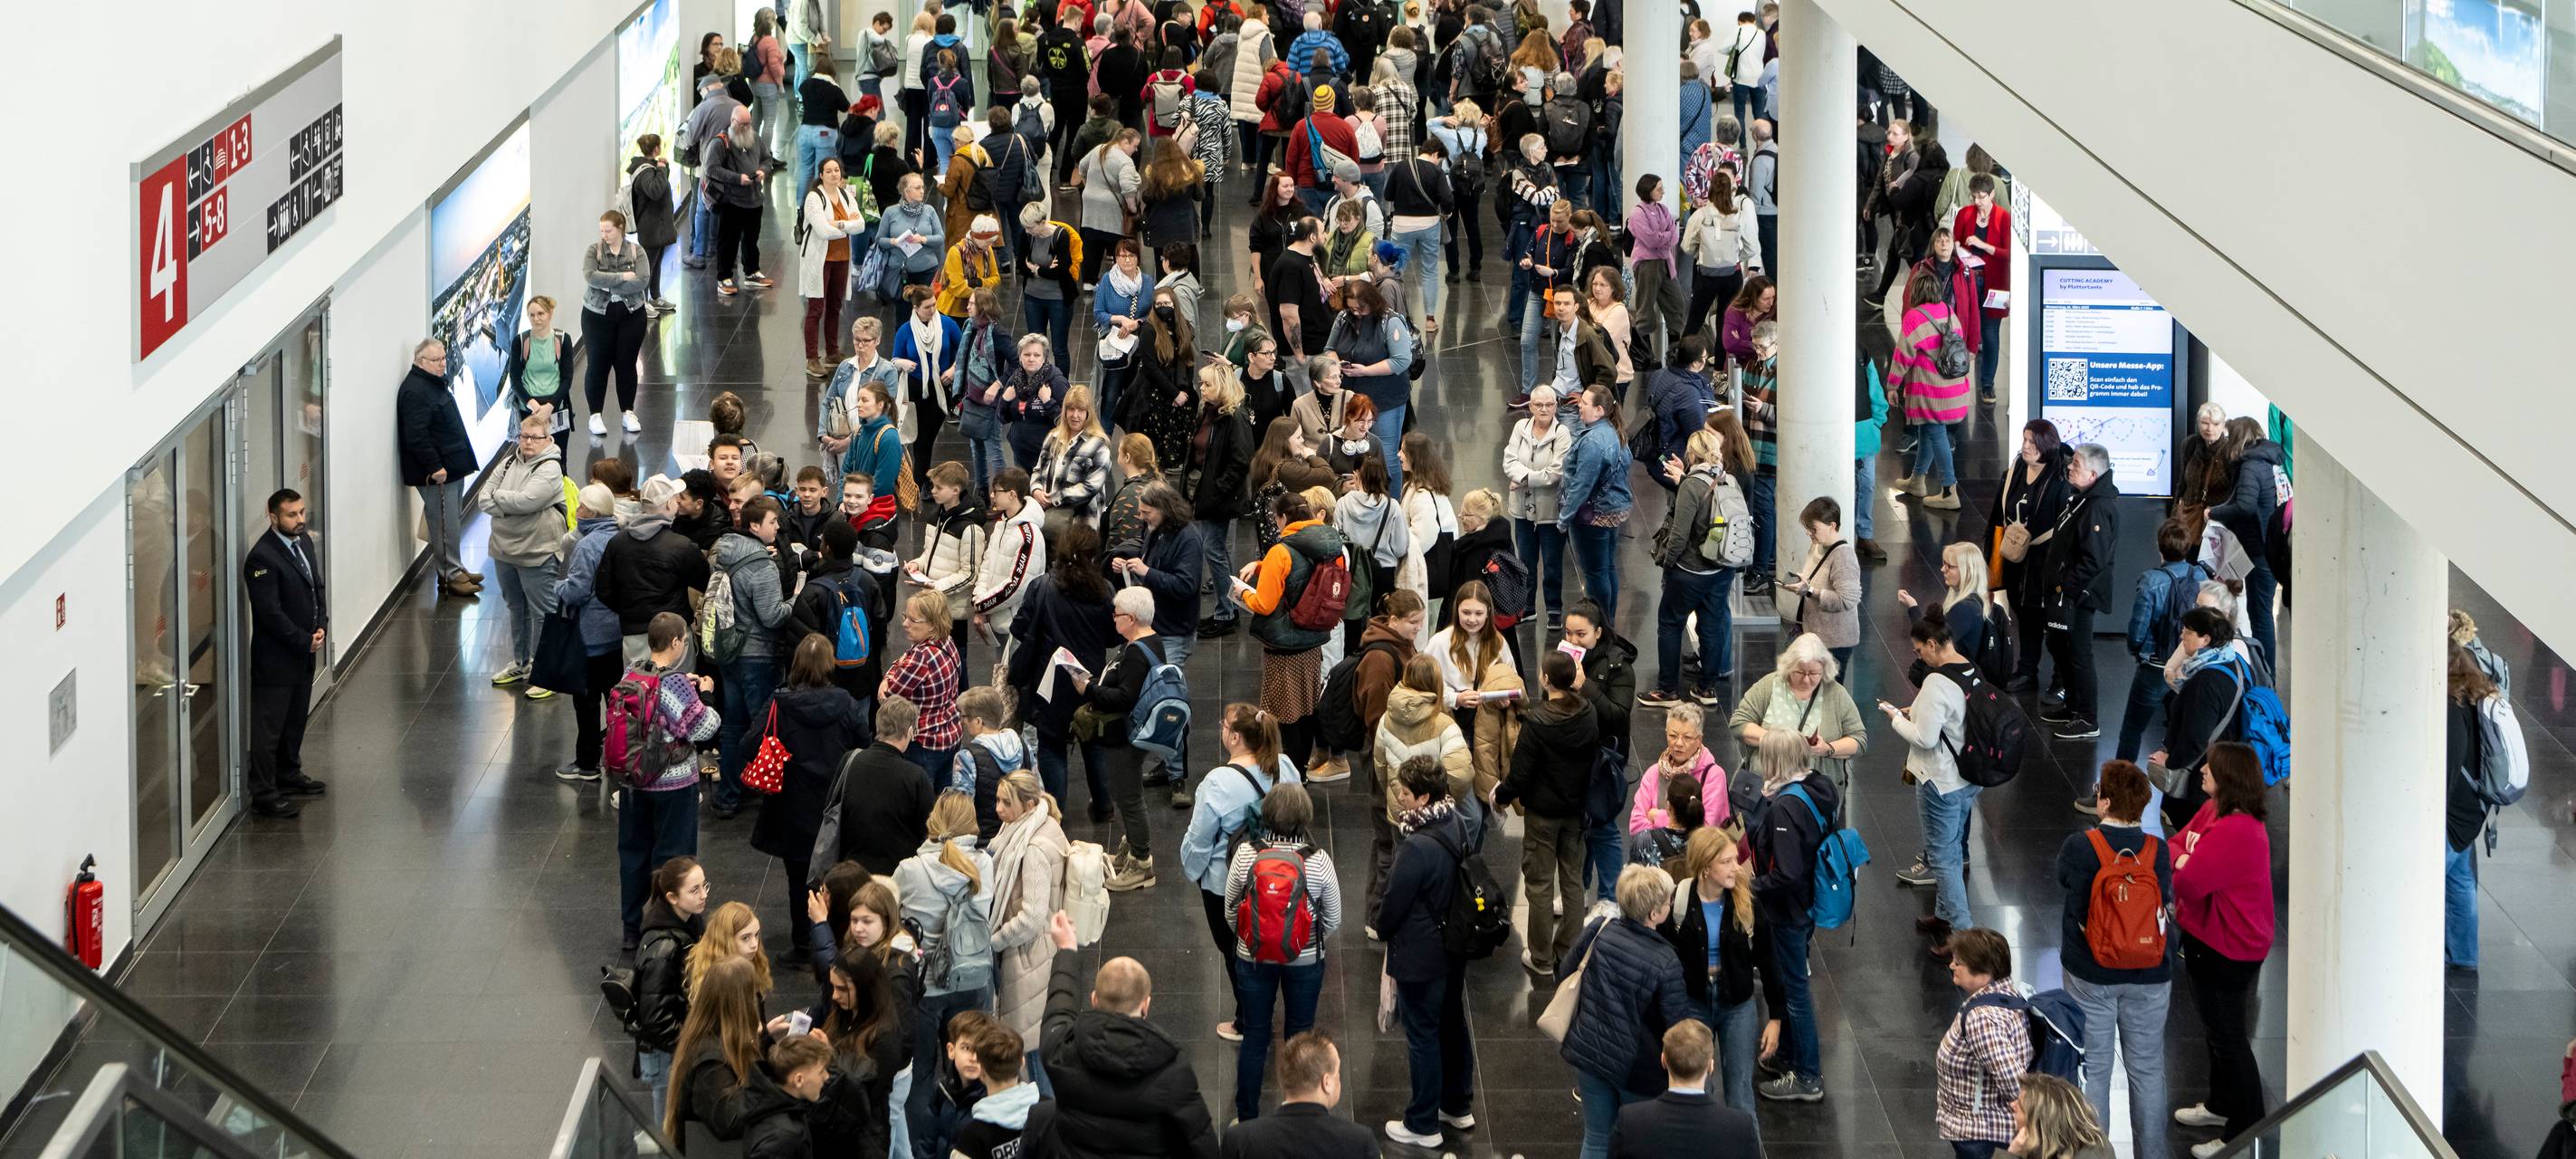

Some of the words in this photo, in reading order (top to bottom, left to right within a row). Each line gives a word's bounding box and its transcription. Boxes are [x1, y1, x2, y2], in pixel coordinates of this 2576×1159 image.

[230, 120, 249, 169] 1-3
[205, 194, 224, 244] 5-8
[150, 181, 177, 323] 4
[2118, 362, 2164, 370] Messe-App:
[1016, 552, 1027, 575] HYPE
